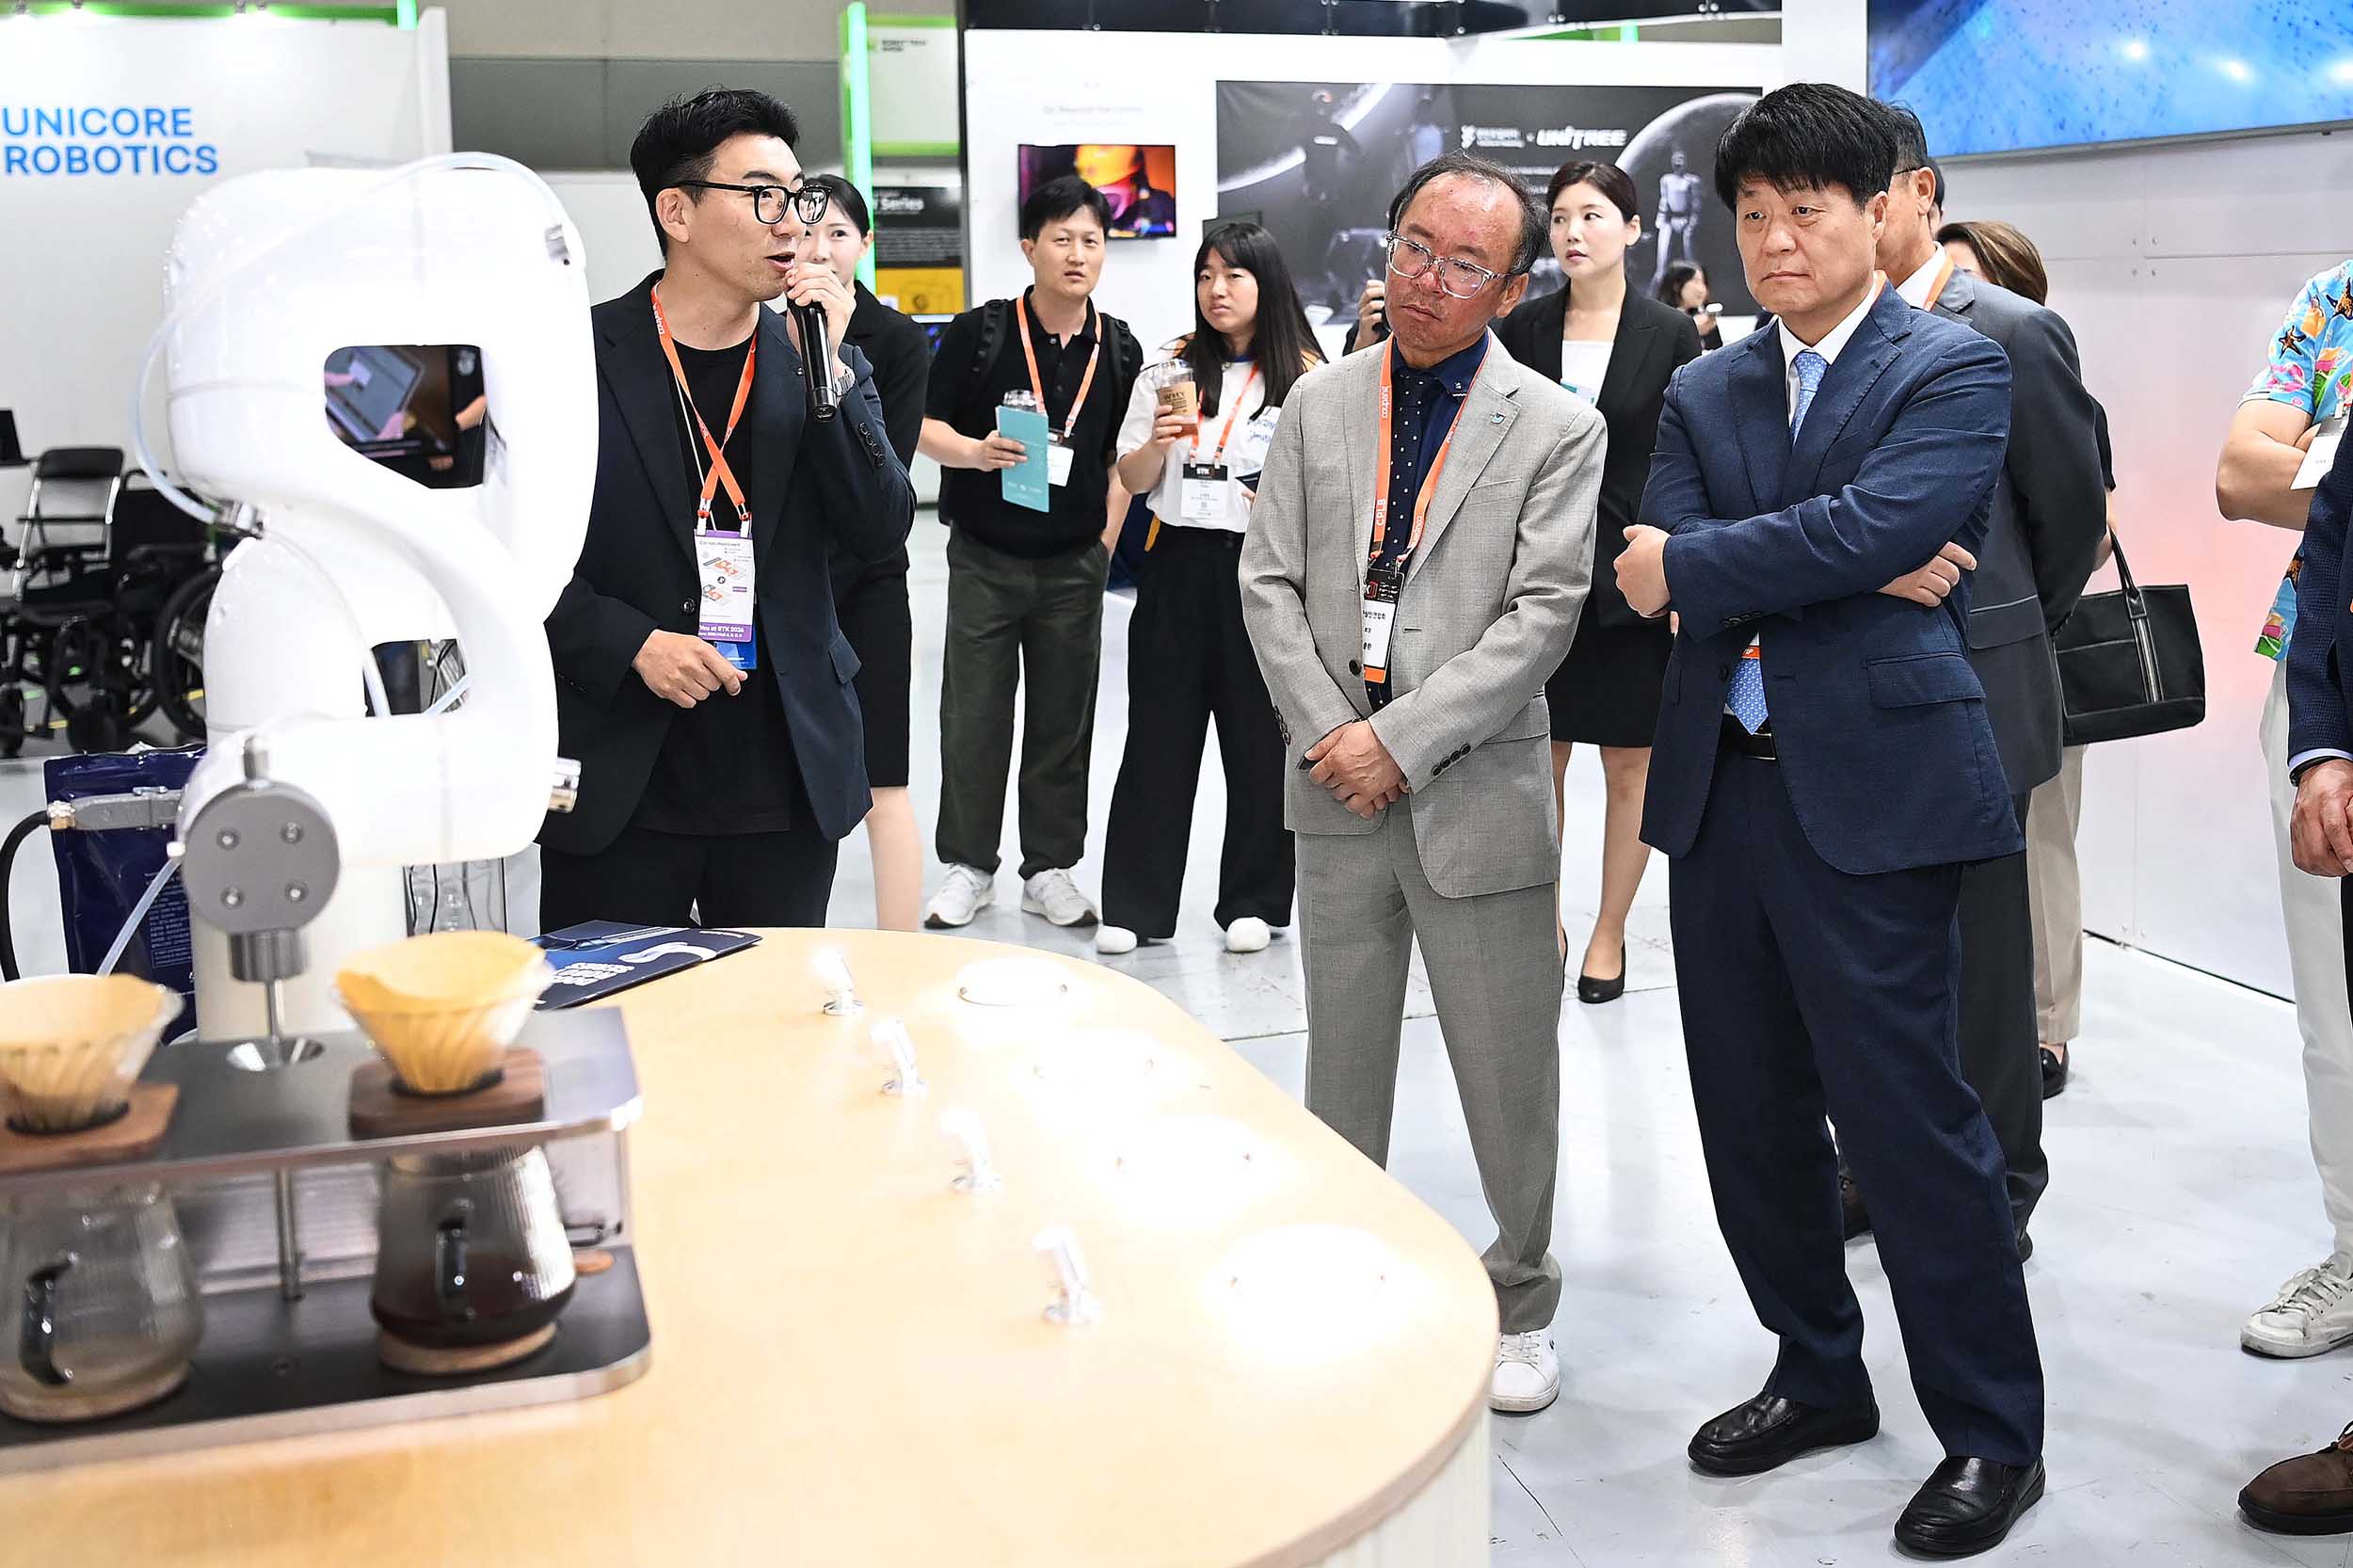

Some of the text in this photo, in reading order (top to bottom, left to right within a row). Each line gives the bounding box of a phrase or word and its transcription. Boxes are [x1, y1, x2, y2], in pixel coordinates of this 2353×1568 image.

[2, 107, 193, 136] UNICORE
[4, 145, 218, 174] ROBOTICS
[1381, 385, 1391, 419] coupang
[1376, 499, 1386, 526] CPLB
